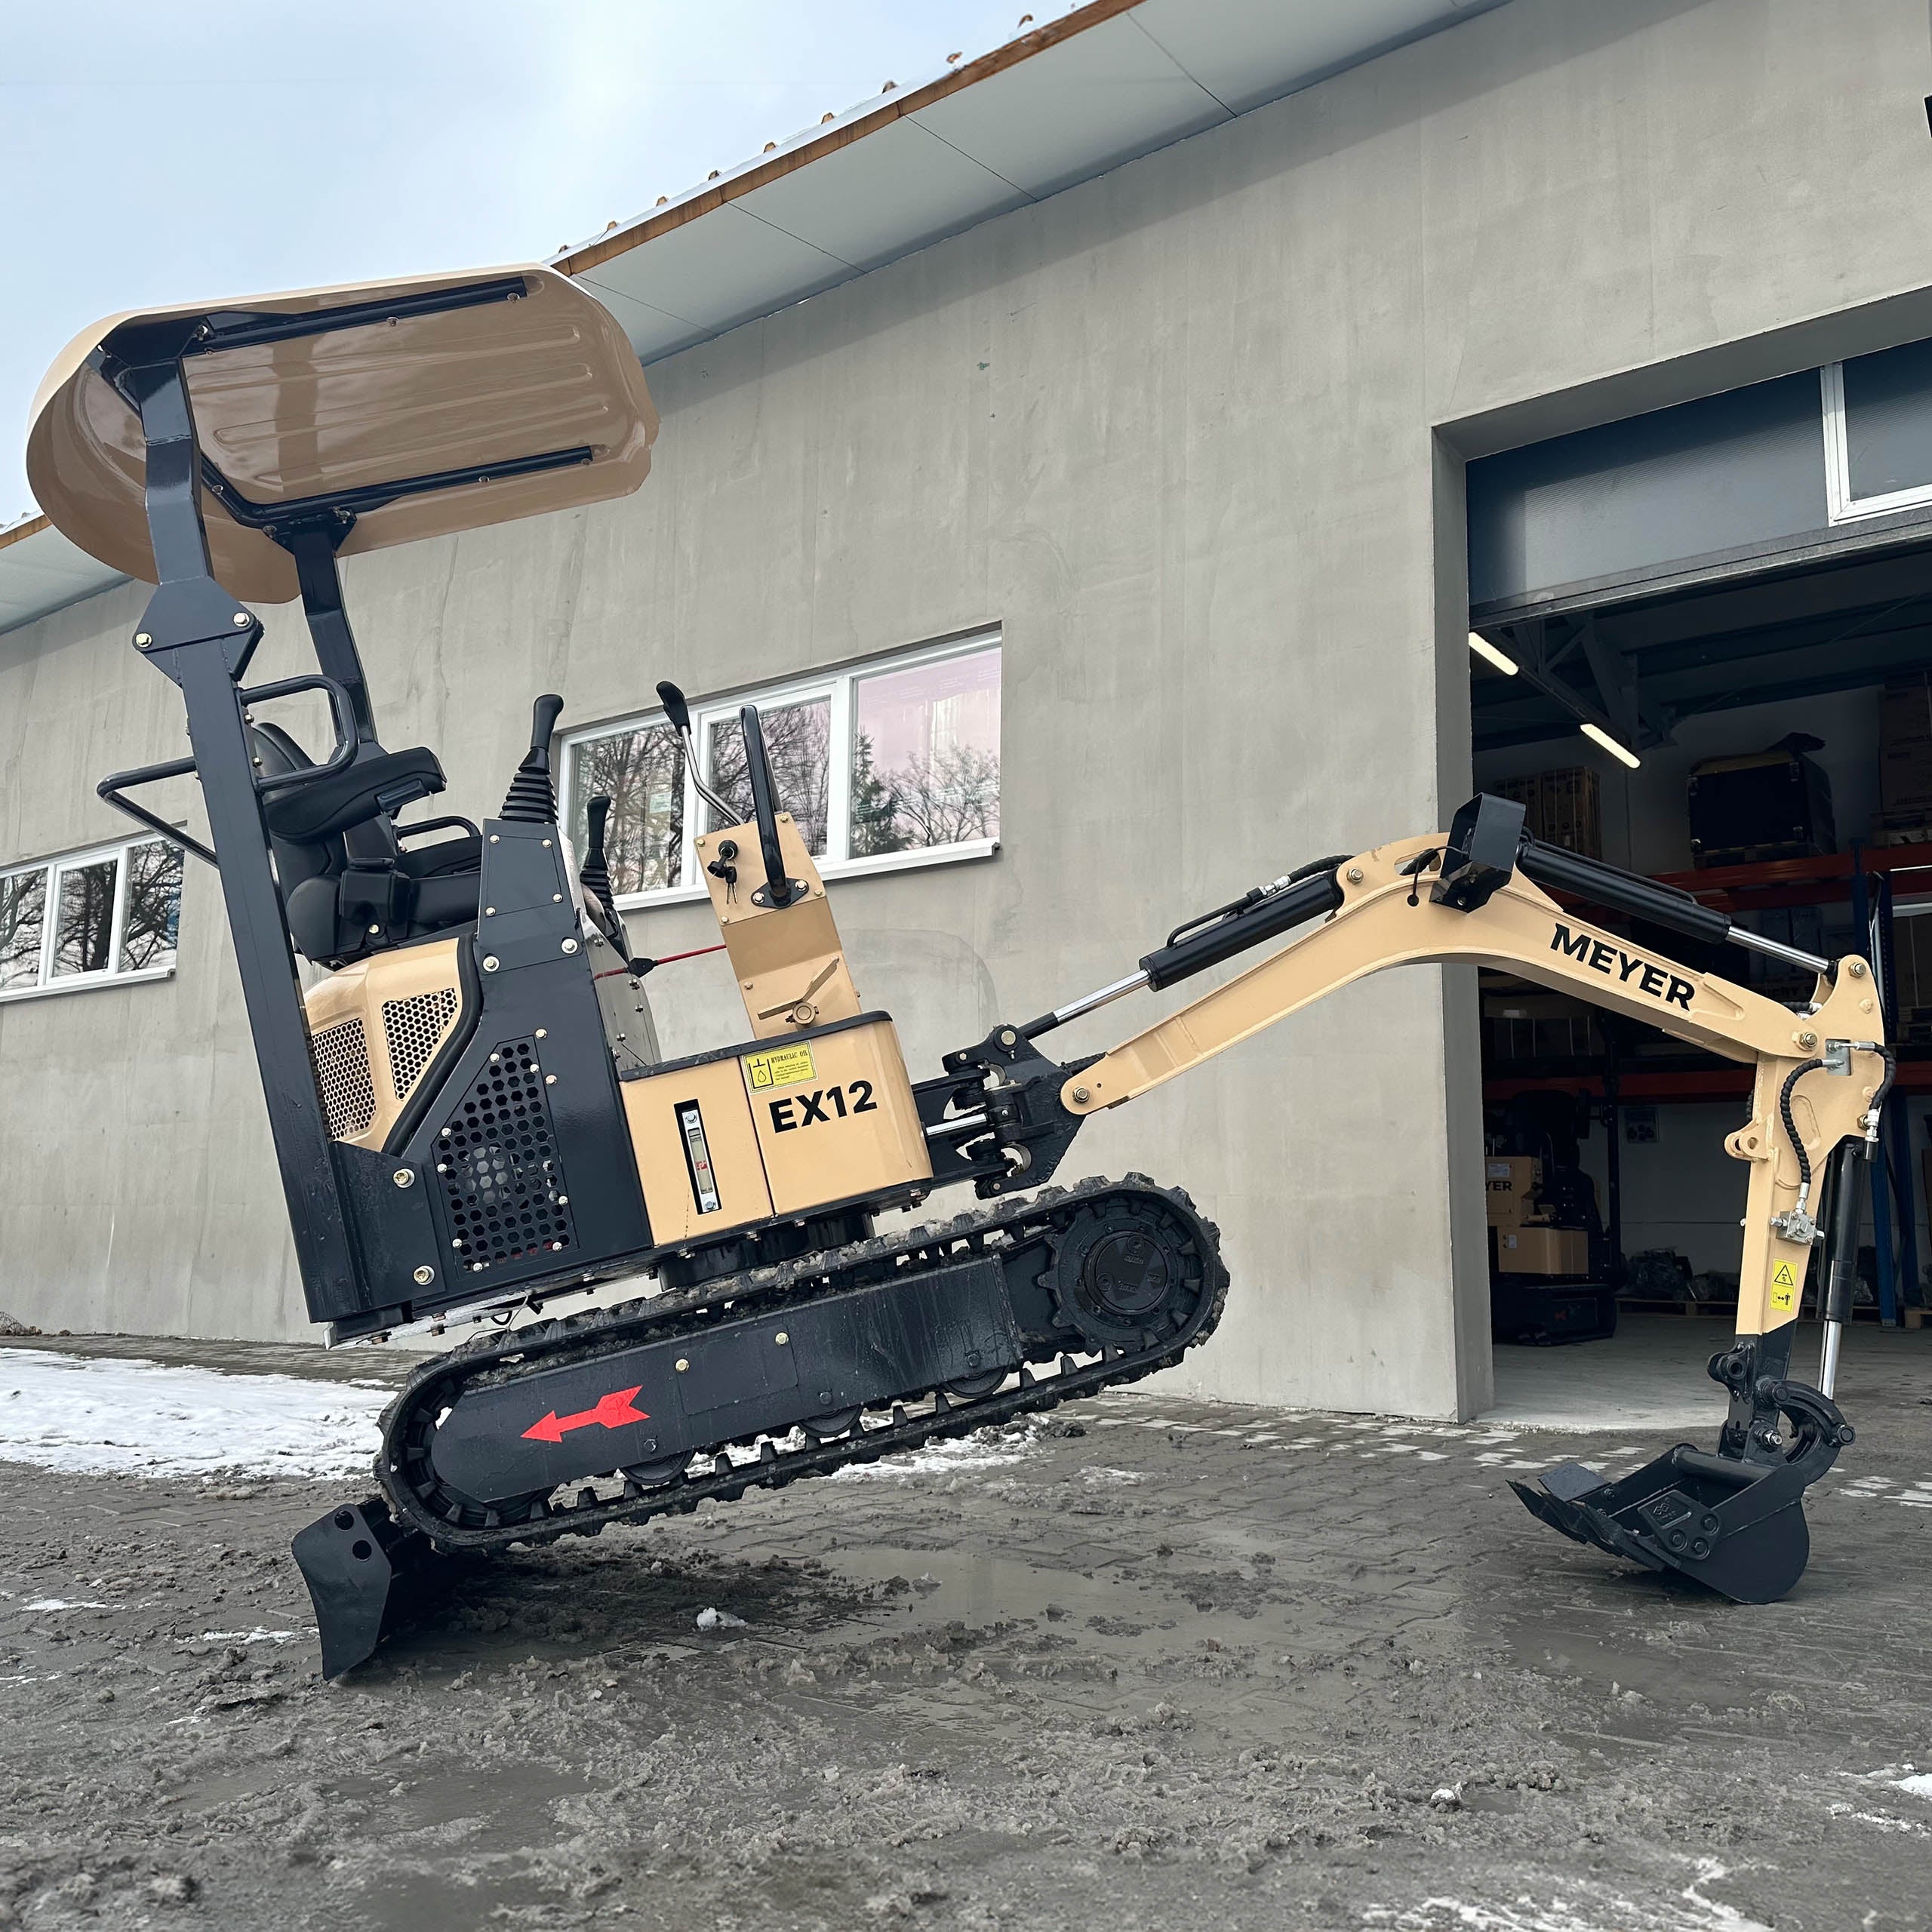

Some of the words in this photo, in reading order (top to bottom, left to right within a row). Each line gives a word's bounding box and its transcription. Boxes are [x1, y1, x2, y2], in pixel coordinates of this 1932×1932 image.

[1550, 922, 1695, 1011] MEYER
[771, 1051, 798, 1063] HYDRAULIC
[768, 1080, 878, 1134] EX12
